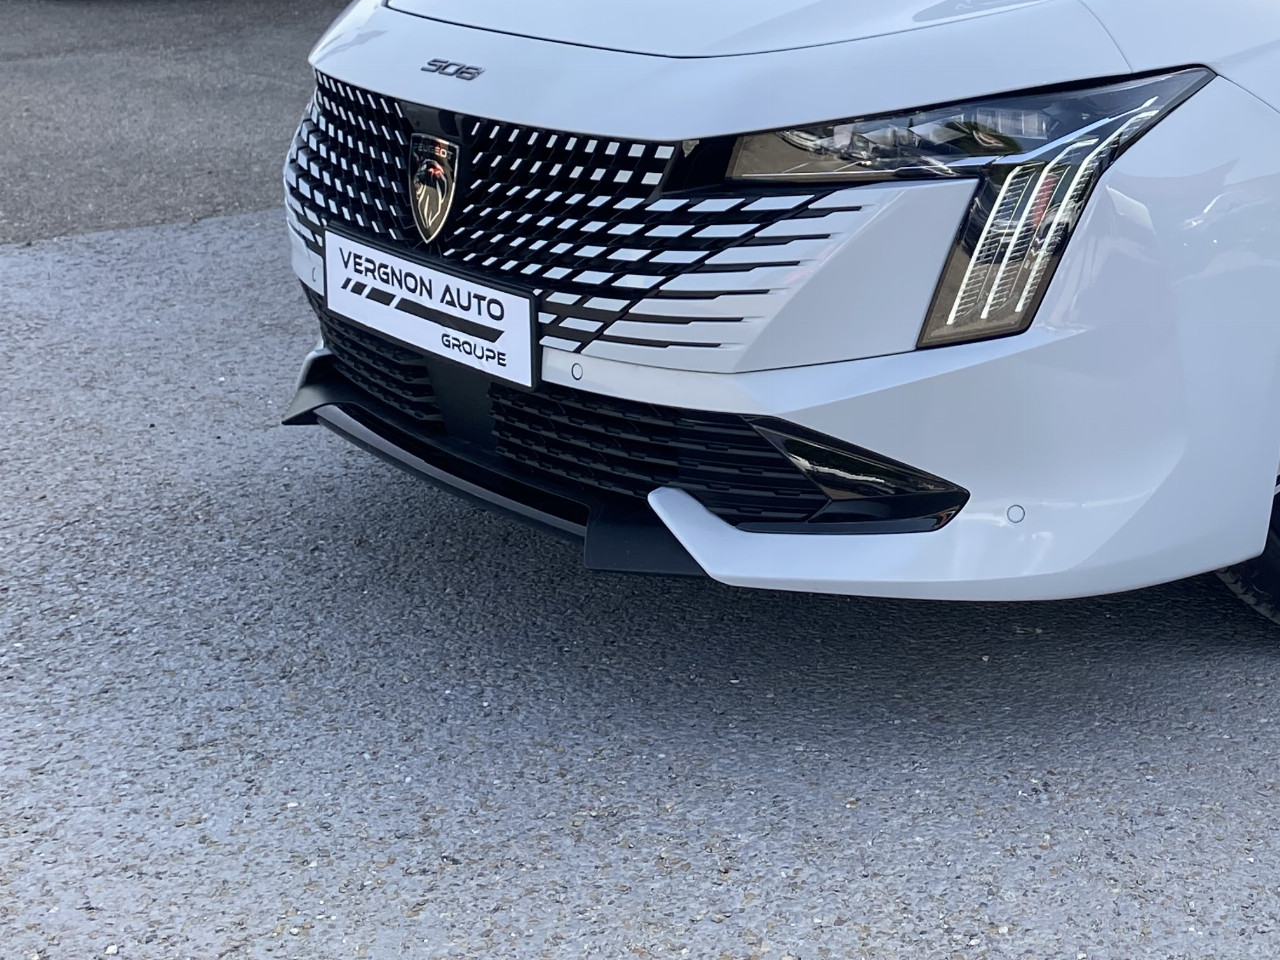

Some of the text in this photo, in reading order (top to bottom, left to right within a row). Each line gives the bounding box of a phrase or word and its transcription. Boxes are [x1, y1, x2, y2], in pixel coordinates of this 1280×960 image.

[420, 58, 486, 81] 508
[339, 247, 506, 322] VERGNON AUTO
[441, 333, 507, 368] GROUPE
